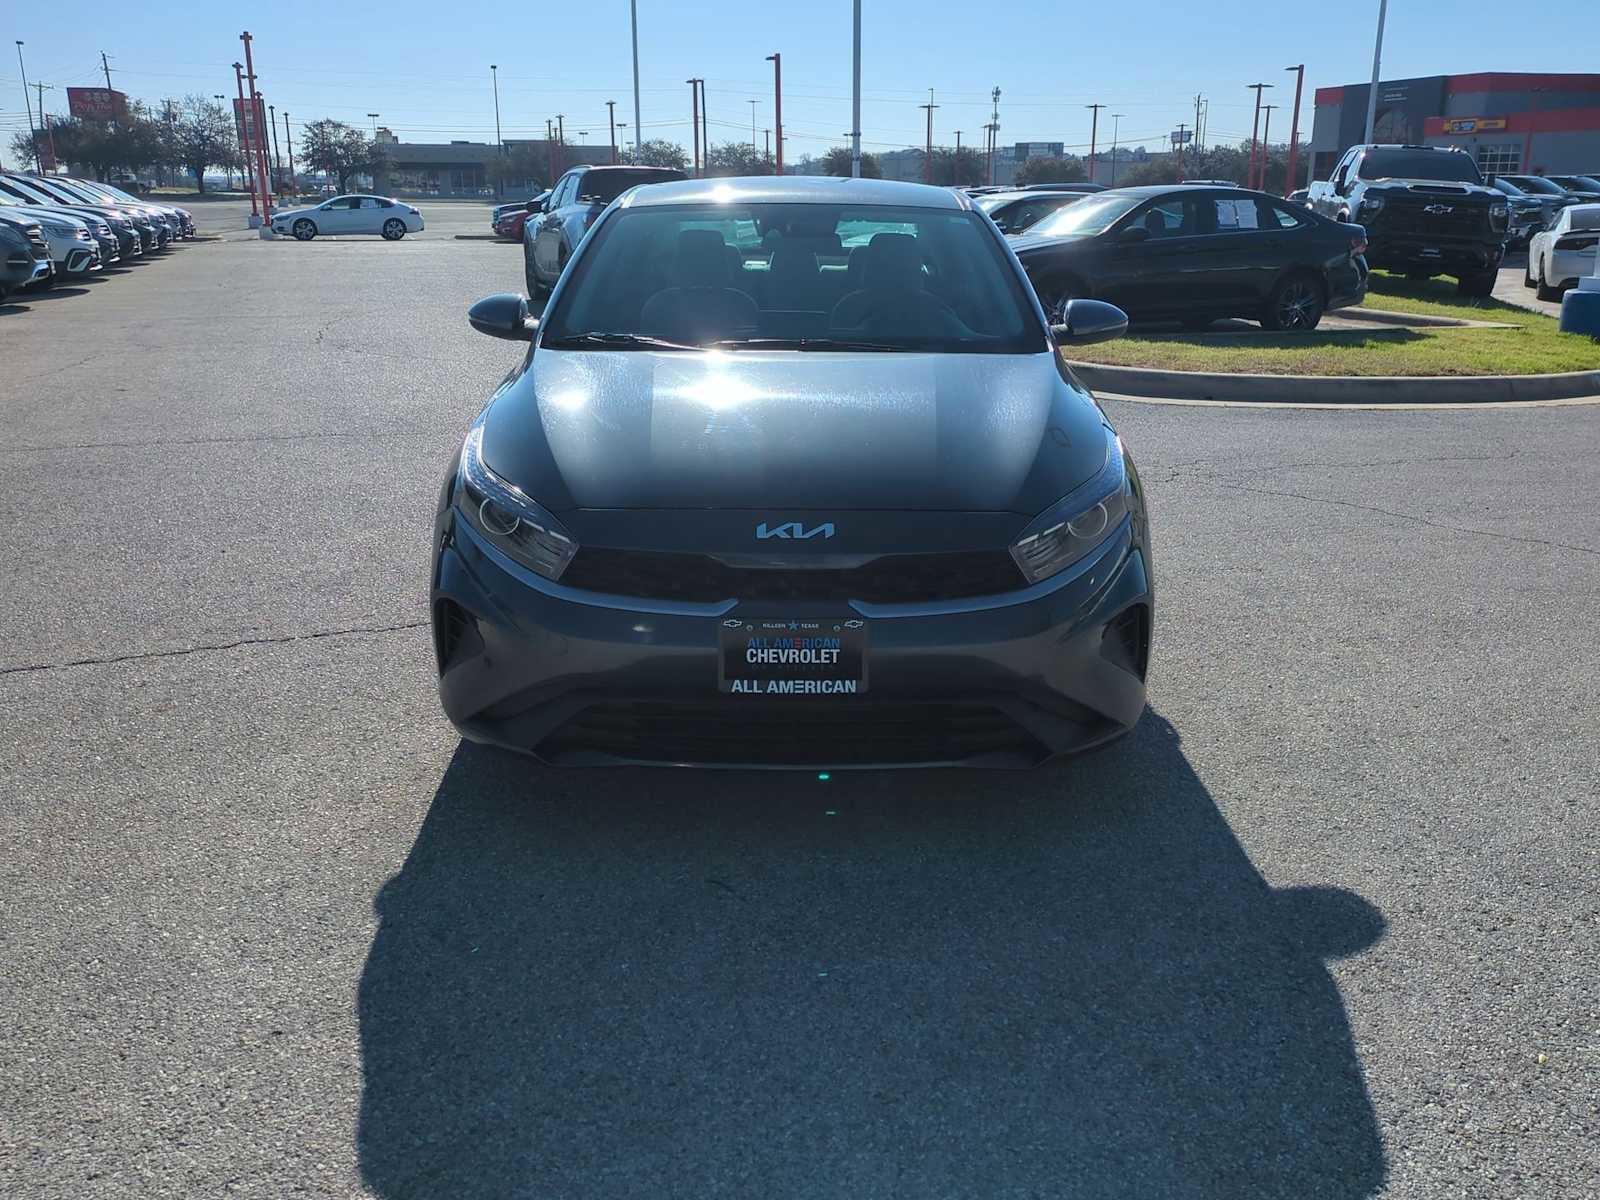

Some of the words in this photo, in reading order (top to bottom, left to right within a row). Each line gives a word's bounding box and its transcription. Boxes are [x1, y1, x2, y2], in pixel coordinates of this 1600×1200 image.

[756, 522, 835, 539] KIA
[747, 638, 770, 648] ALL
[774, 637, 840, 648] AMERICAN
[746, 649, 840, 664] CHEVROLET
[731, 680, 763, 693] ALL
[767, 680, 856, 693] AMERICAN
